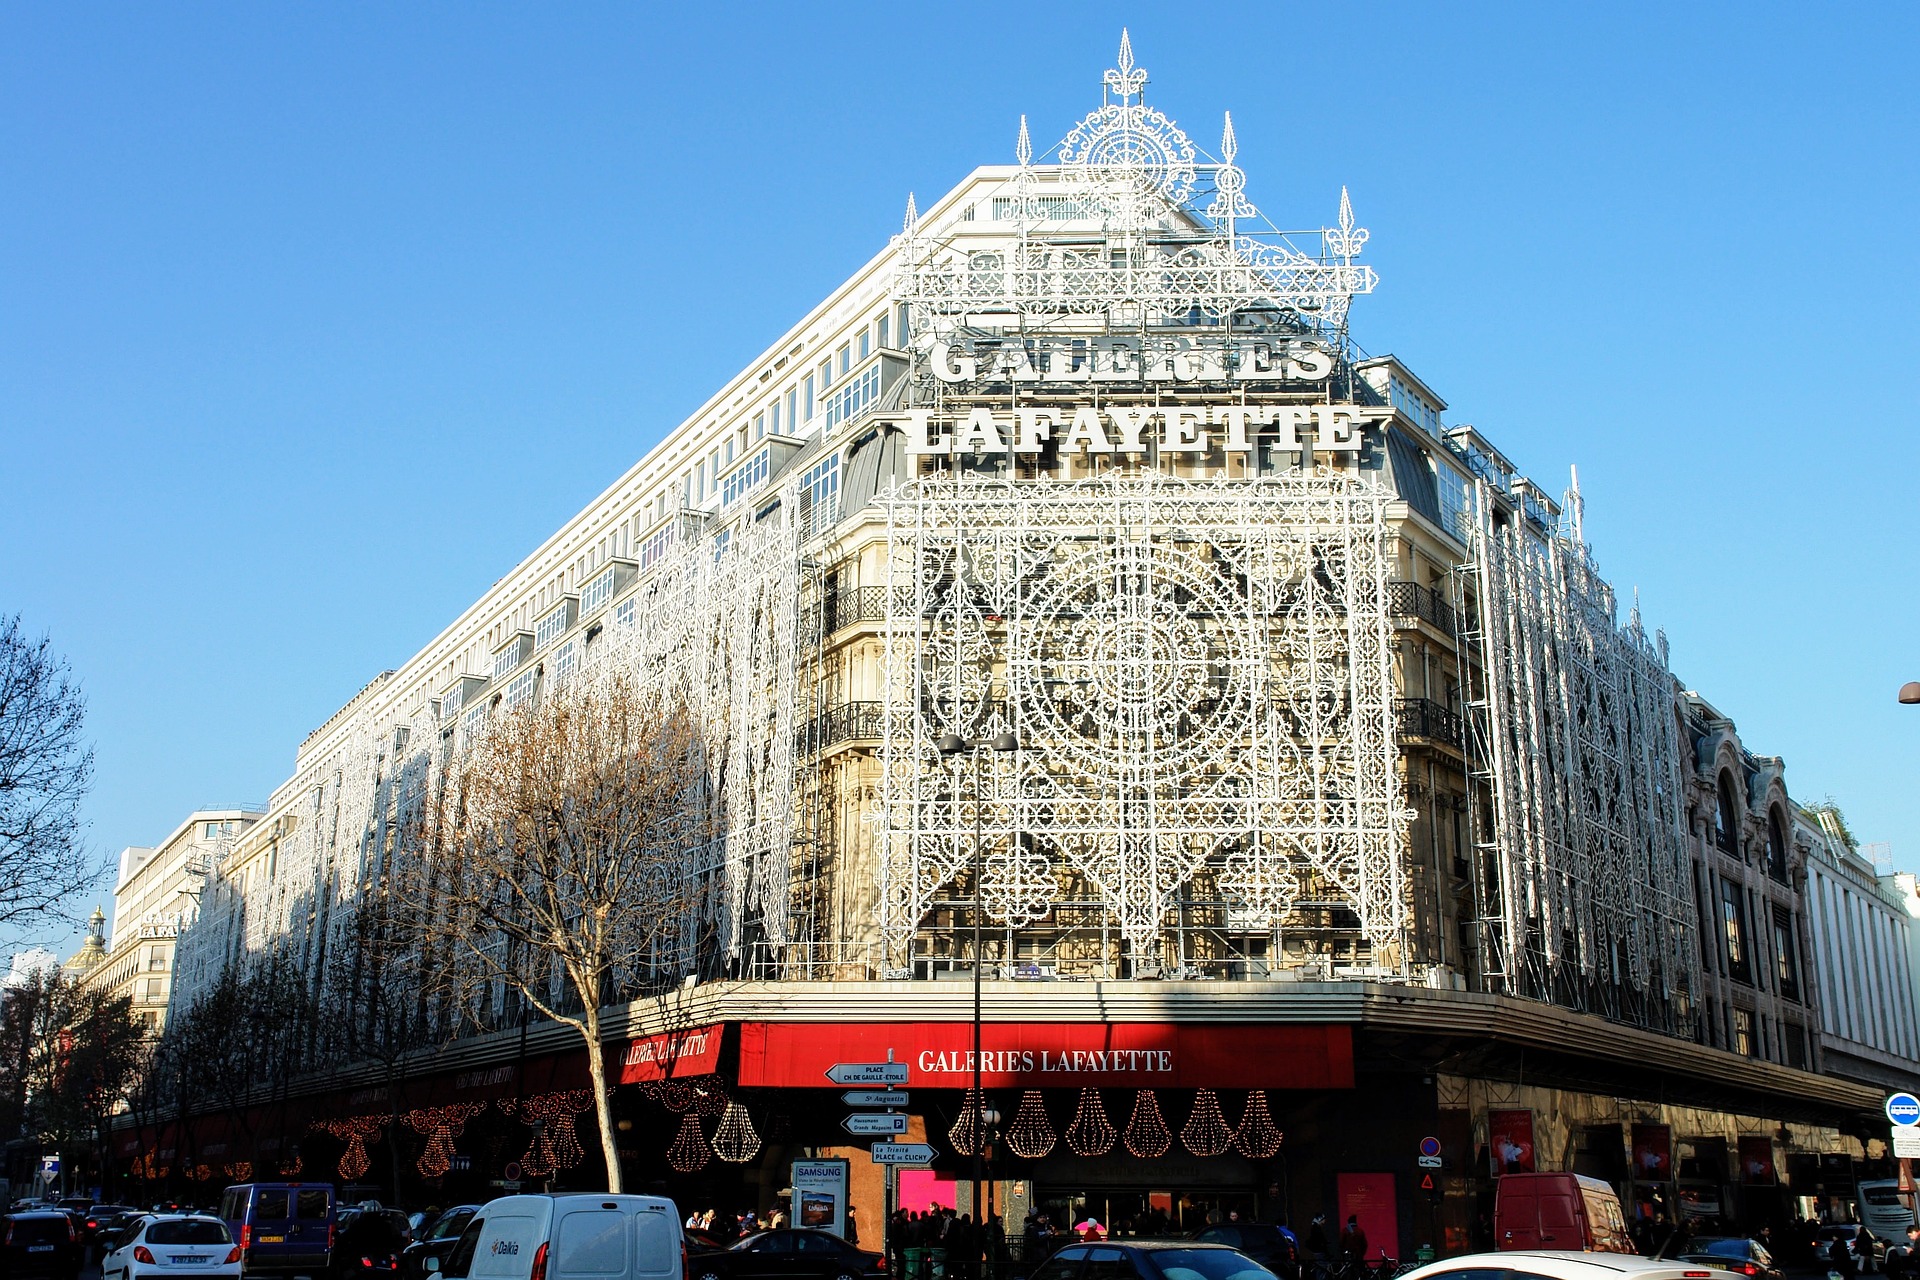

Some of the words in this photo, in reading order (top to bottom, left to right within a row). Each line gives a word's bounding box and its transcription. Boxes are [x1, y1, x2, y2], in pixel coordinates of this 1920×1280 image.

[931, 336, 1333, 383] GALERIES
[905, 407, 1362, 454] LAFAYETTE
[918, 1050, 1034, 1073] GALERIES
[1040, 1050, 1172, 1072] LAFAYETTE
[798, 1167, 841, 1176] SAMSUNG
[498, 1241, 519, 1255] Dalkia
